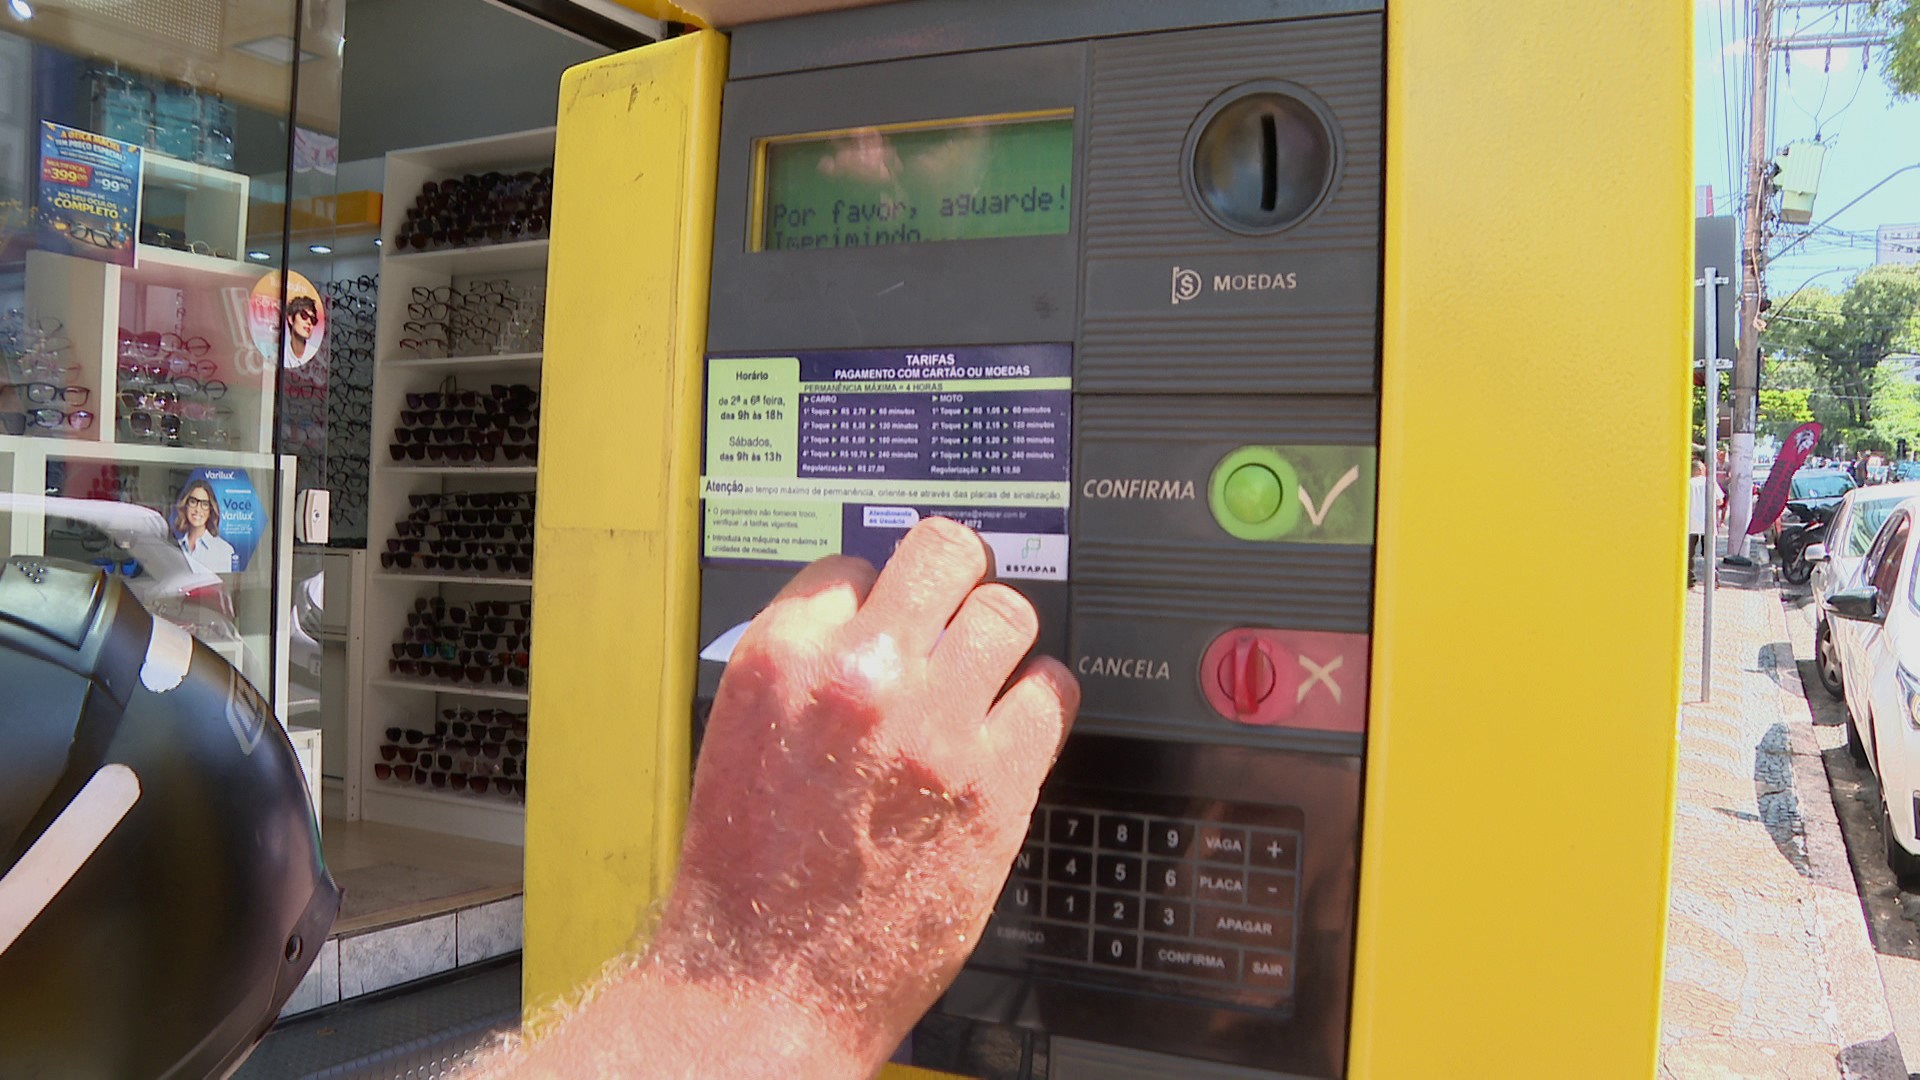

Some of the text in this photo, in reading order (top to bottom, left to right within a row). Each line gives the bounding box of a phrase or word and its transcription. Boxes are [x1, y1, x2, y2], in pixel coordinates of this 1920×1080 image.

[54, 197, 119, 219] COMPLETO
[774, 184, 1065, 227] Por favor, aguarde!
[1213, 272, 1298, 291] MOEDAS
[906, 353, 956, 366] TARIFAS
[736, 370, 769, 380] Horário
[835, 364, 1031, 380] PAGAMENTO COM CARTÃO OU MOEDAS
[804, 382, 862, 392] PERMANÊNCIA
[864, 382, 897, 391] MÁXIMA
[913, 383, 943, 391] HORAS
[718, 397, 728, 406] de
[810, 395, 837, 403] CARRO
[940, 394, 964, 402] MOTO
[738, 410, 749, 420] 9h
[766, 410, 783, 420] 18h
[729, 435, 772, 448] Sábados,
[737, 451, 748, 461] 9h
[765, 451, 782, 461] 13h
[204, 470, 235, 479] Varilux
[705, 480, 744, 496] Atenção
[920, 490, 950, 499] através
[1082, 479, 1196, 500] CONFIRMA
[1006, 565, 1057, 573] ESTAPAR
[1078, 655, 1170, 680] CANCELA
[1068, 819, 1079, 837] 7
[1116, 824, 1128, 842] 8
[1167, 830, 1179, 848] 9
[1206, 836, 1242, 852] VAGA
[1065, 858, 1077, 875] 4
[1114, 863, 1126, 881] 5
[1165, 869, 1177, 887] 6
[1199, 875, 1242, 891] PLACA
[1016, 889, 1029, 906] U
[1066, 896, 1075, 912] 1
[1113, 902, 1125, 919] 2
[1163, 908, 1175, 925] 3
[1216, 917, 1273, 936] APAGAR
[1158, 949, 1225, 969] CONFIRMA
[1251, 961, 1283, 977] SAIR
